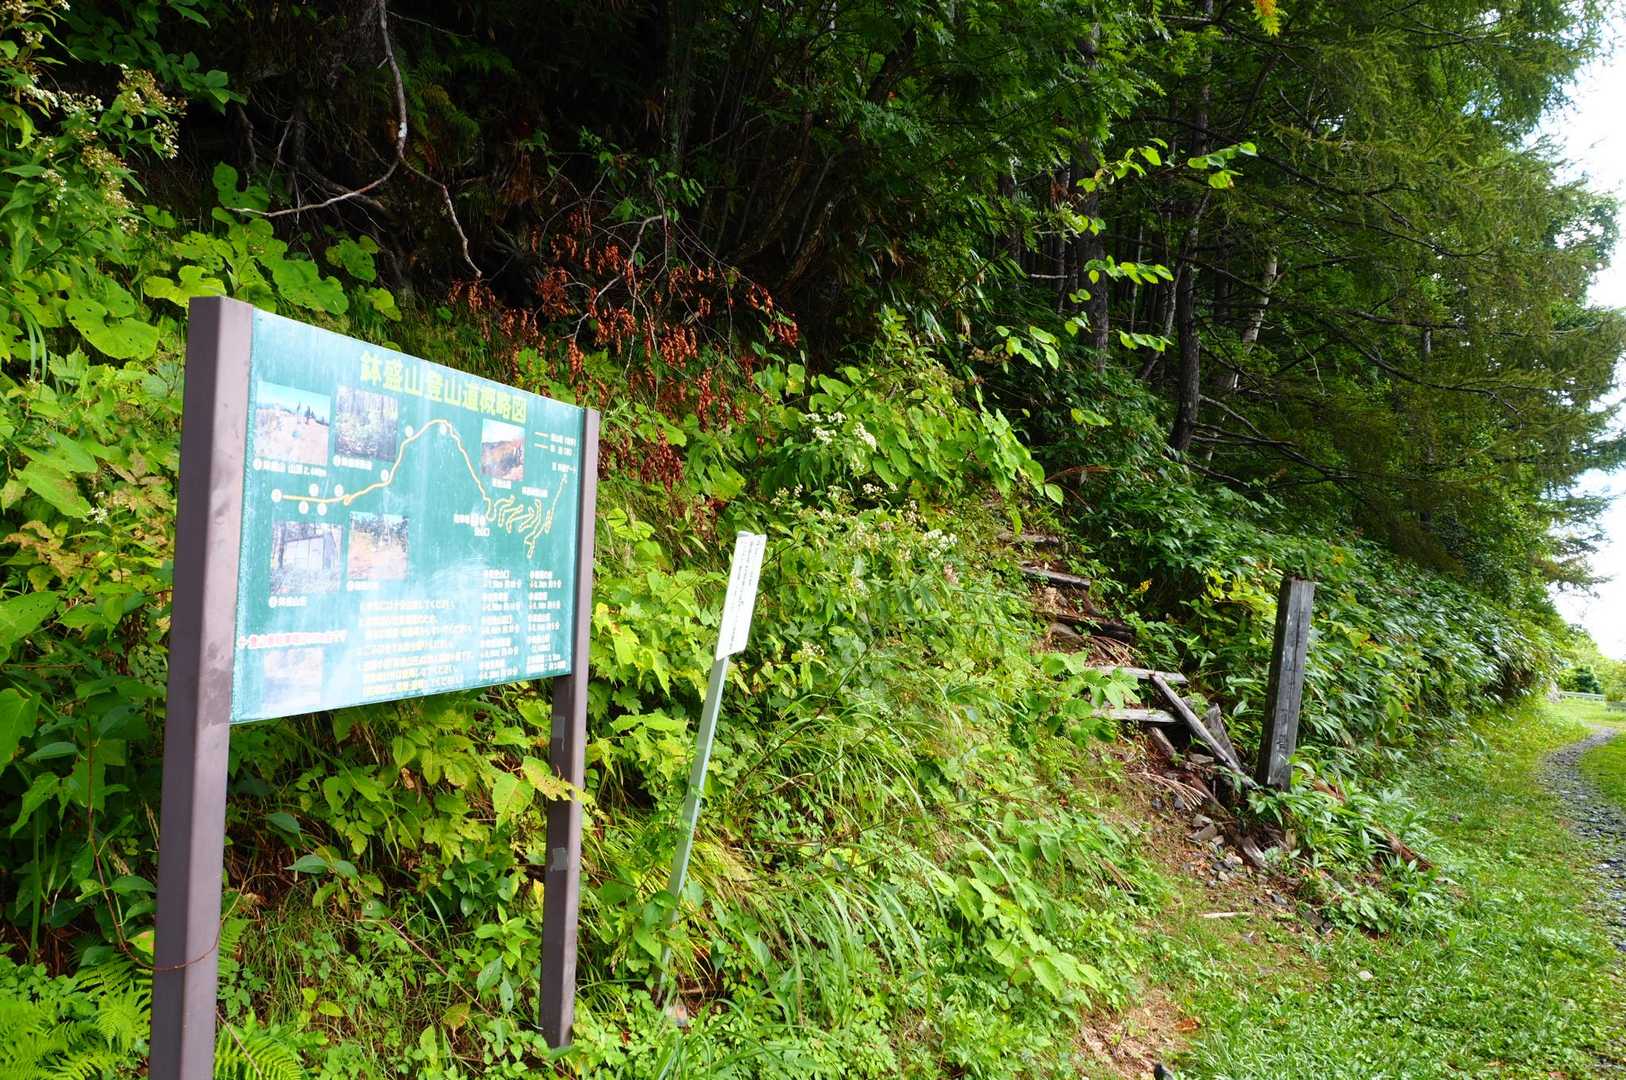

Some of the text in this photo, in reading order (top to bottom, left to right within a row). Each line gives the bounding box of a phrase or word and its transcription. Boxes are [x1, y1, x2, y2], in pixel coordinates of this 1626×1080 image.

[360, 351, 528, 423] 鉢盛山登山道概略図
